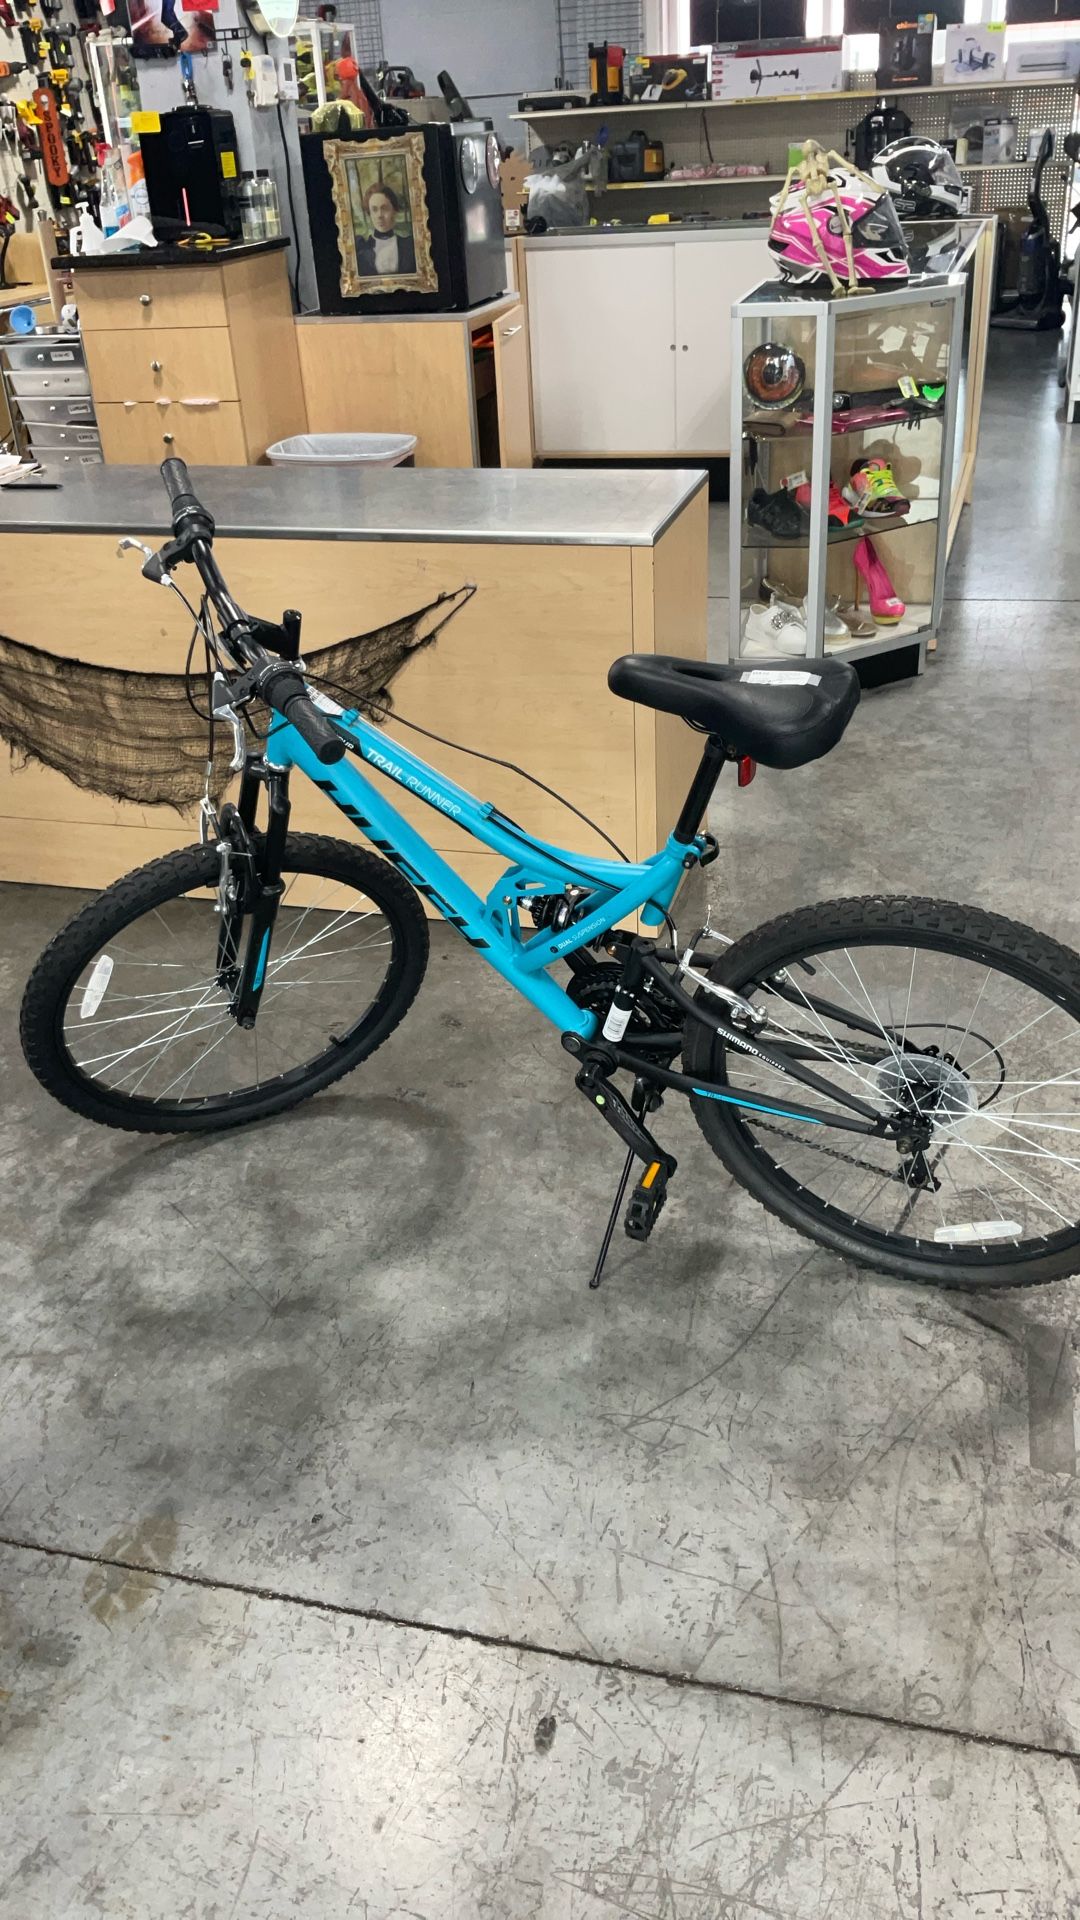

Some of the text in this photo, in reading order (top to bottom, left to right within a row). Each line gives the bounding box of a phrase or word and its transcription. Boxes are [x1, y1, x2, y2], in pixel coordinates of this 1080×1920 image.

[43, 111, 61, 177] SPOOKY
[366, 748, 462, 817] TRAIL RUNNER
[558, 917, 606, 949] DUAL SUSPENSION
[716, 1027, 759, 1056] SHIMANO
